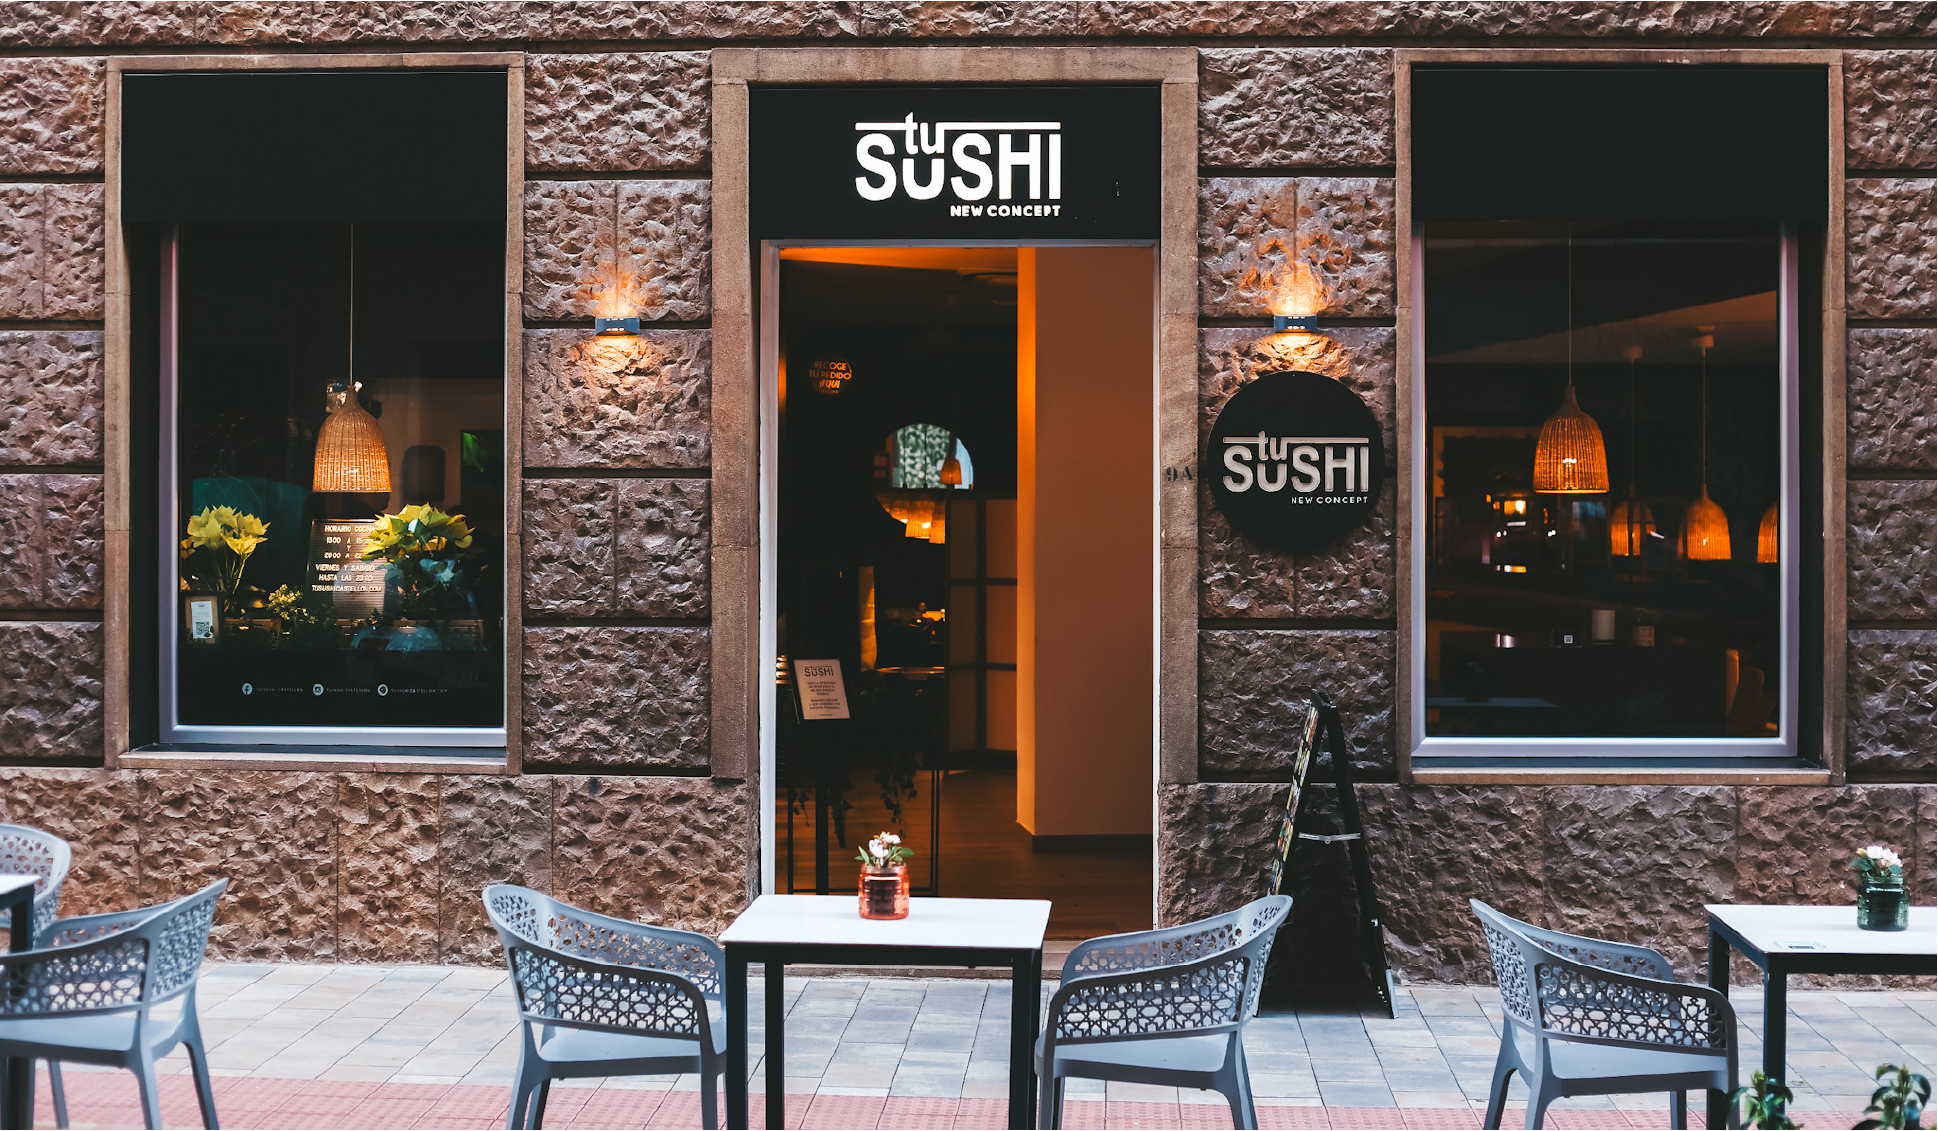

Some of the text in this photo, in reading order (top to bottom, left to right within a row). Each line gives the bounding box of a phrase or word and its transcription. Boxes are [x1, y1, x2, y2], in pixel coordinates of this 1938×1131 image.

[905, 112, 944, 154] tu
[855, 132, 1061, 201] SUSHI
[950, 205, 1061, 217] NEW CONCEPT
[820, 371, 852, 380] PEDIDO
[1258, 431, 1287, 460] tu
[1223, 445, 1369, 492] SUSHI
[804, 668, 834, 677] SUSHI
